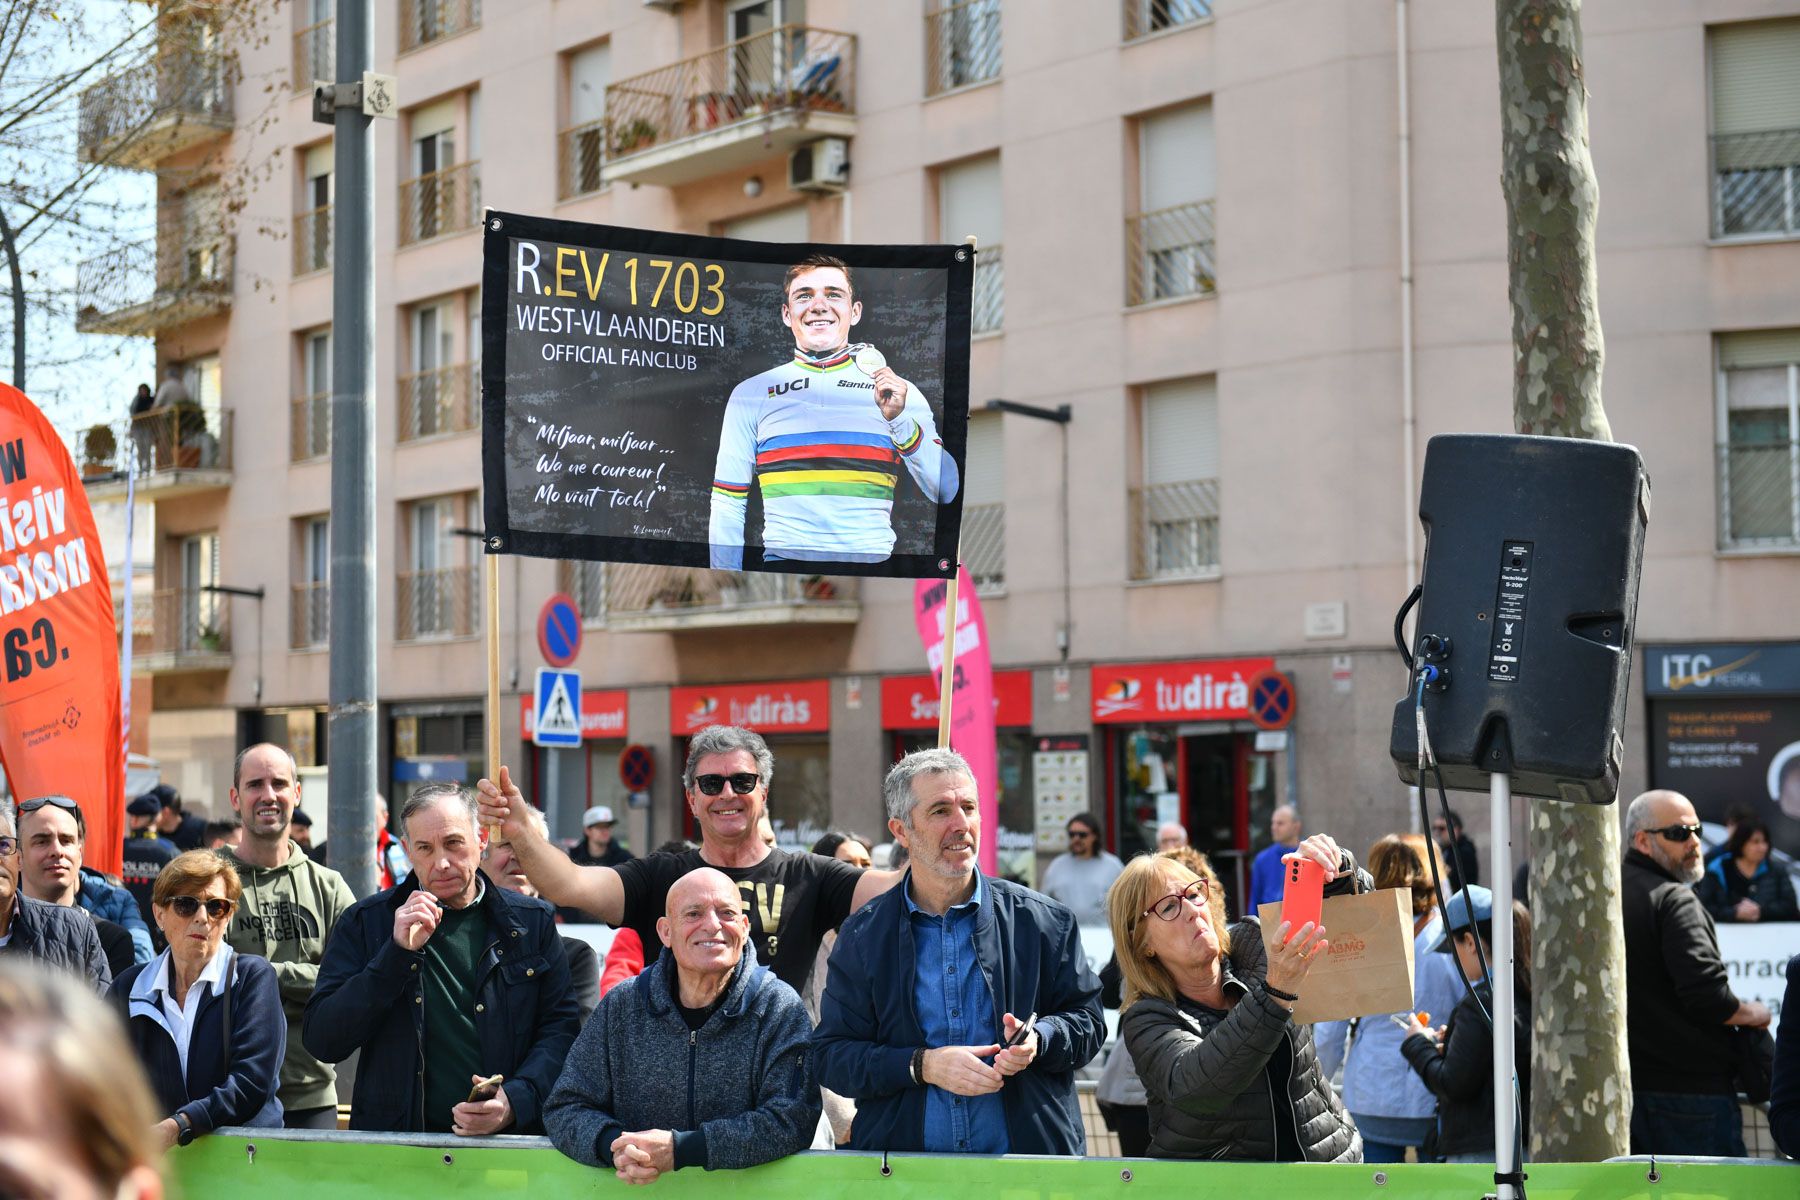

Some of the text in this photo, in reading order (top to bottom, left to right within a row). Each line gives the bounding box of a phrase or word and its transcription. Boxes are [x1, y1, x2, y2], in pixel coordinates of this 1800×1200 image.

[516, 241, 725, 316] R.EV 1703
[516, 304, 725, 347] WEST-VLAANDEREN
[541, 343, 697, 371] OFFICIAL FANCLUB
[775, 377, 810, 396] UCI
[837, 379, 876, 390] Santin
[535, 451, 562, 473] Wa
[592, 462, 666, 484] coureur!
[534, 483, 561, 505] Mo
[565, 486, 606, 508] vint
[1662, 653, 1712, 688] ITC
[1156, 672, 1250, 712] tudirà
[730, 693, 810, 726] tudiràs
[260, 901, 289, 915] THE
[238, 914, 291, 931] NORTH
[258, 928, 293, 942] FACE
